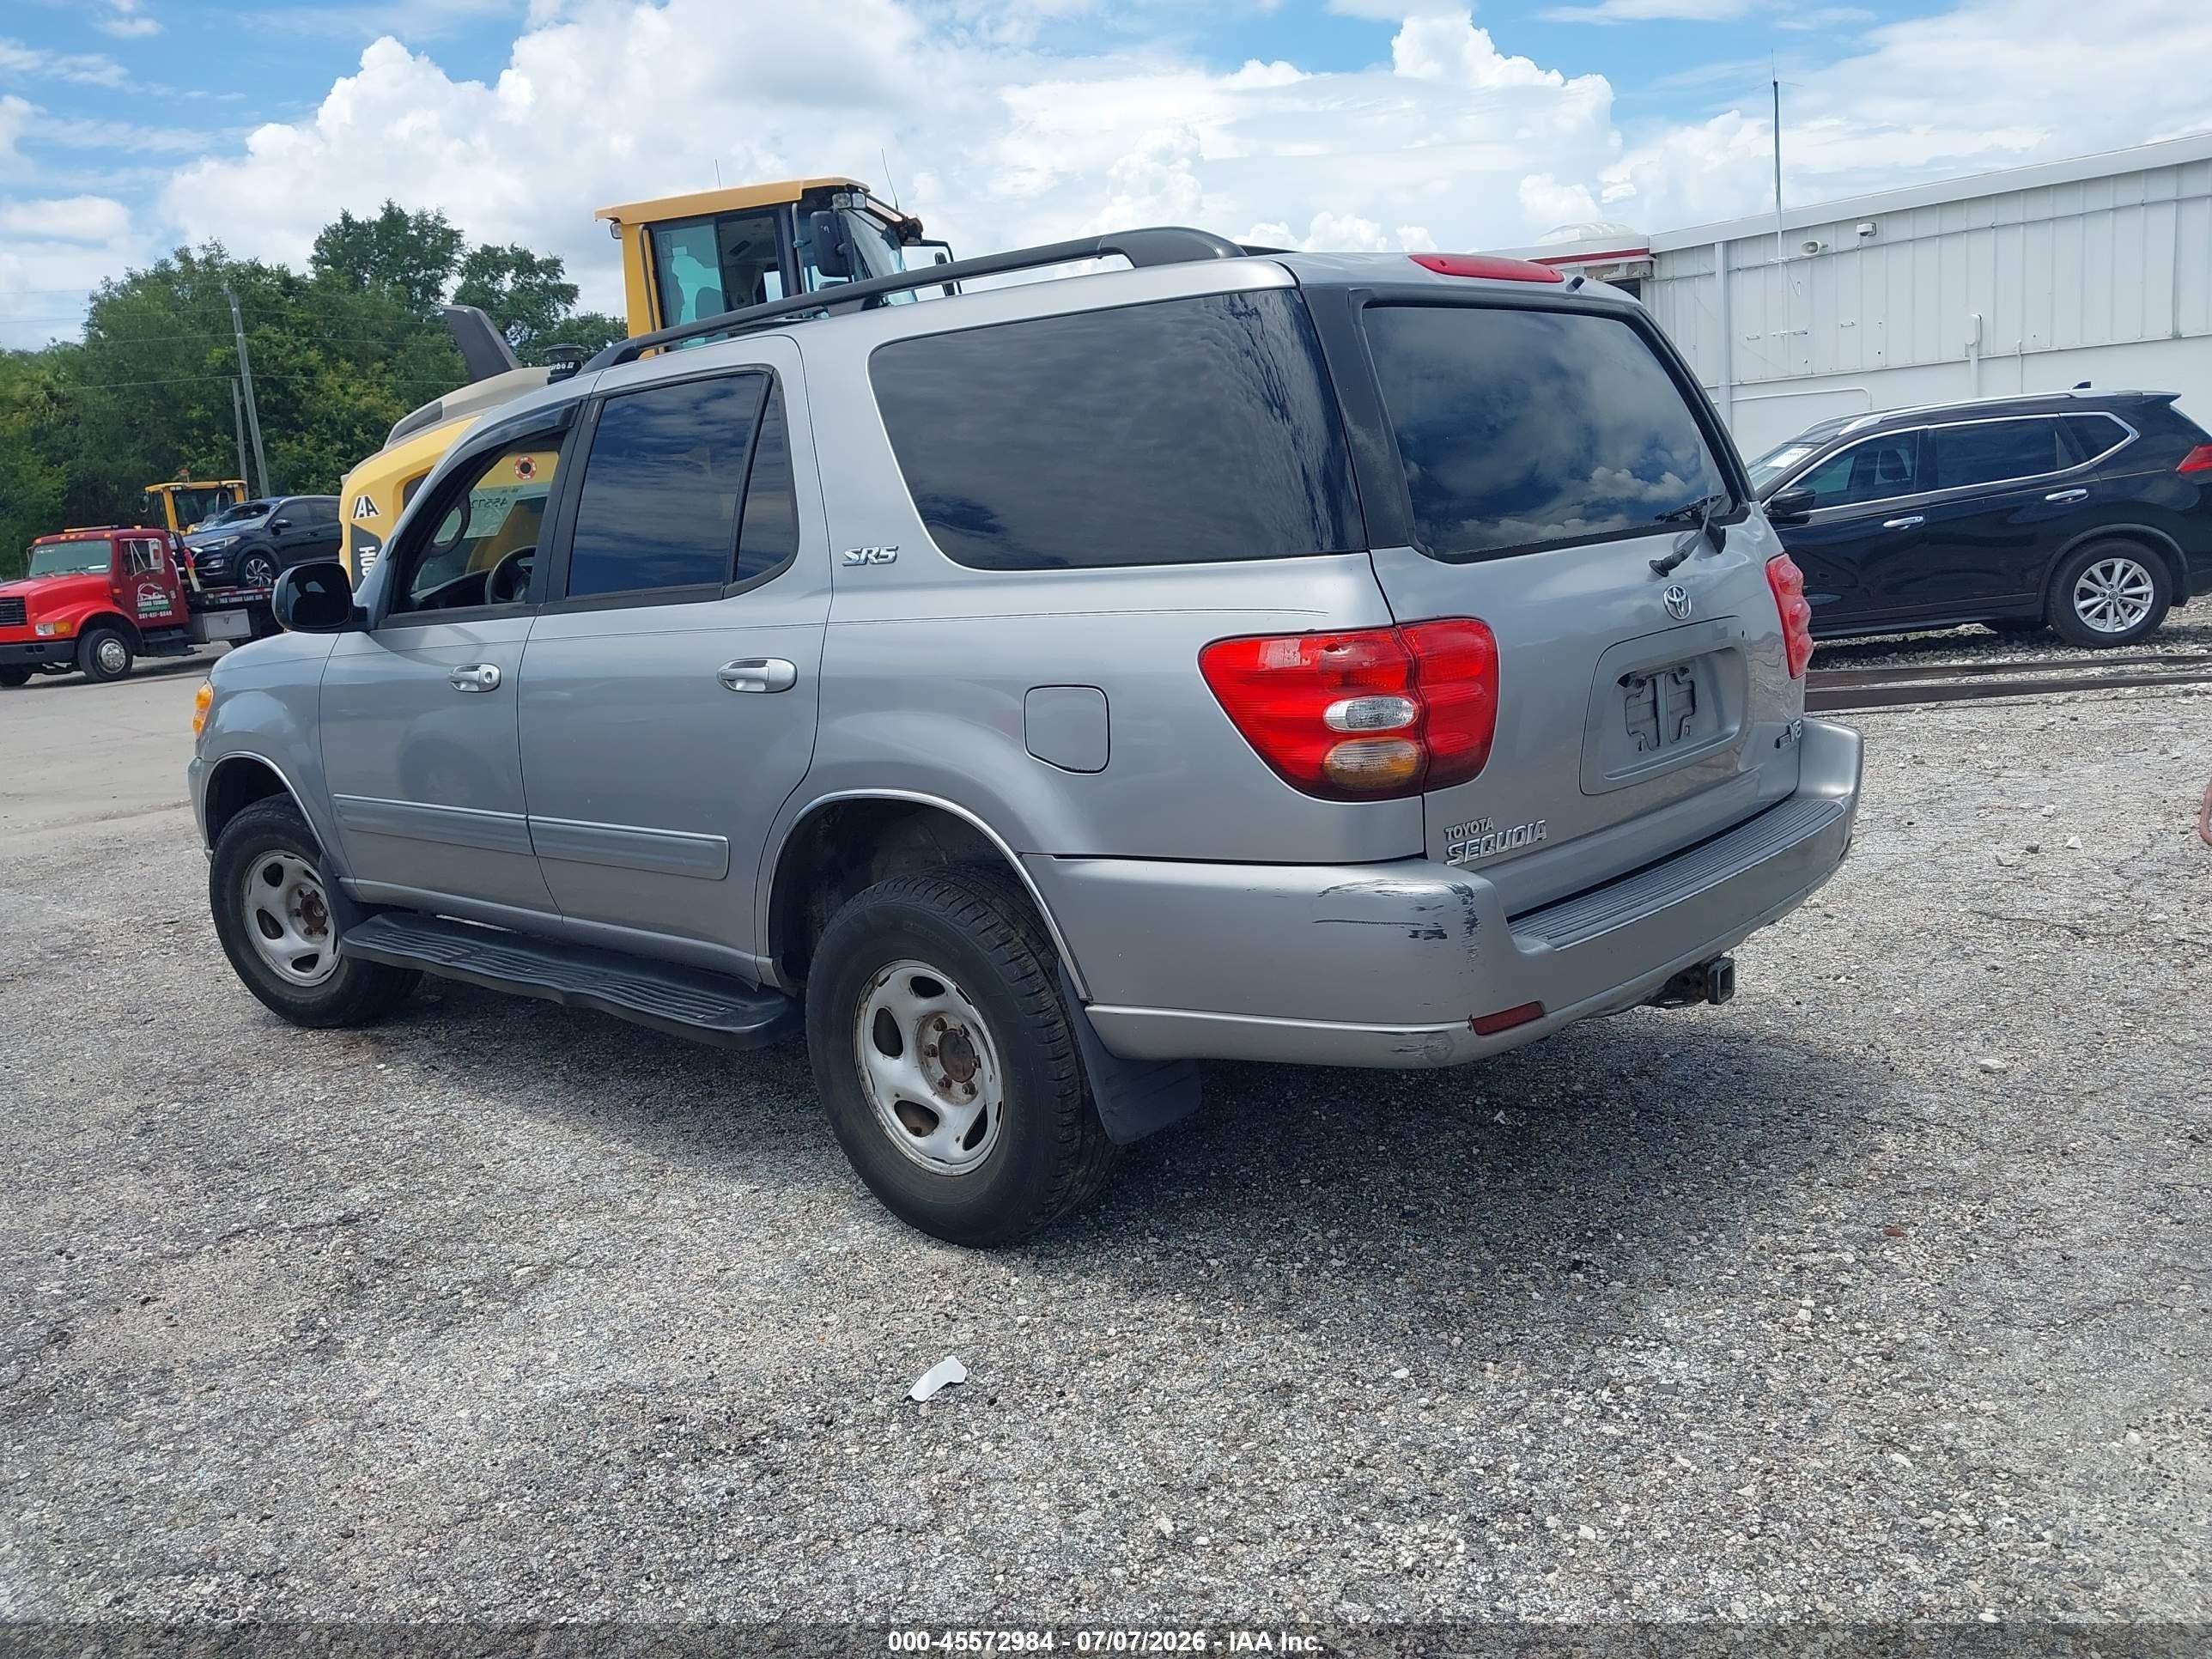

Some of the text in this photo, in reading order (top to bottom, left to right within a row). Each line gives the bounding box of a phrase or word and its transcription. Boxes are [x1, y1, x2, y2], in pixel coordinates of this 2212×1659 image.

[842, 545, 899, 567] SR5
[1790, 720, 1802, 743] V8
[1444, 817, 1494, 842] TOYOTA
[1445, 819, 1548, 866] SEQUOIA
